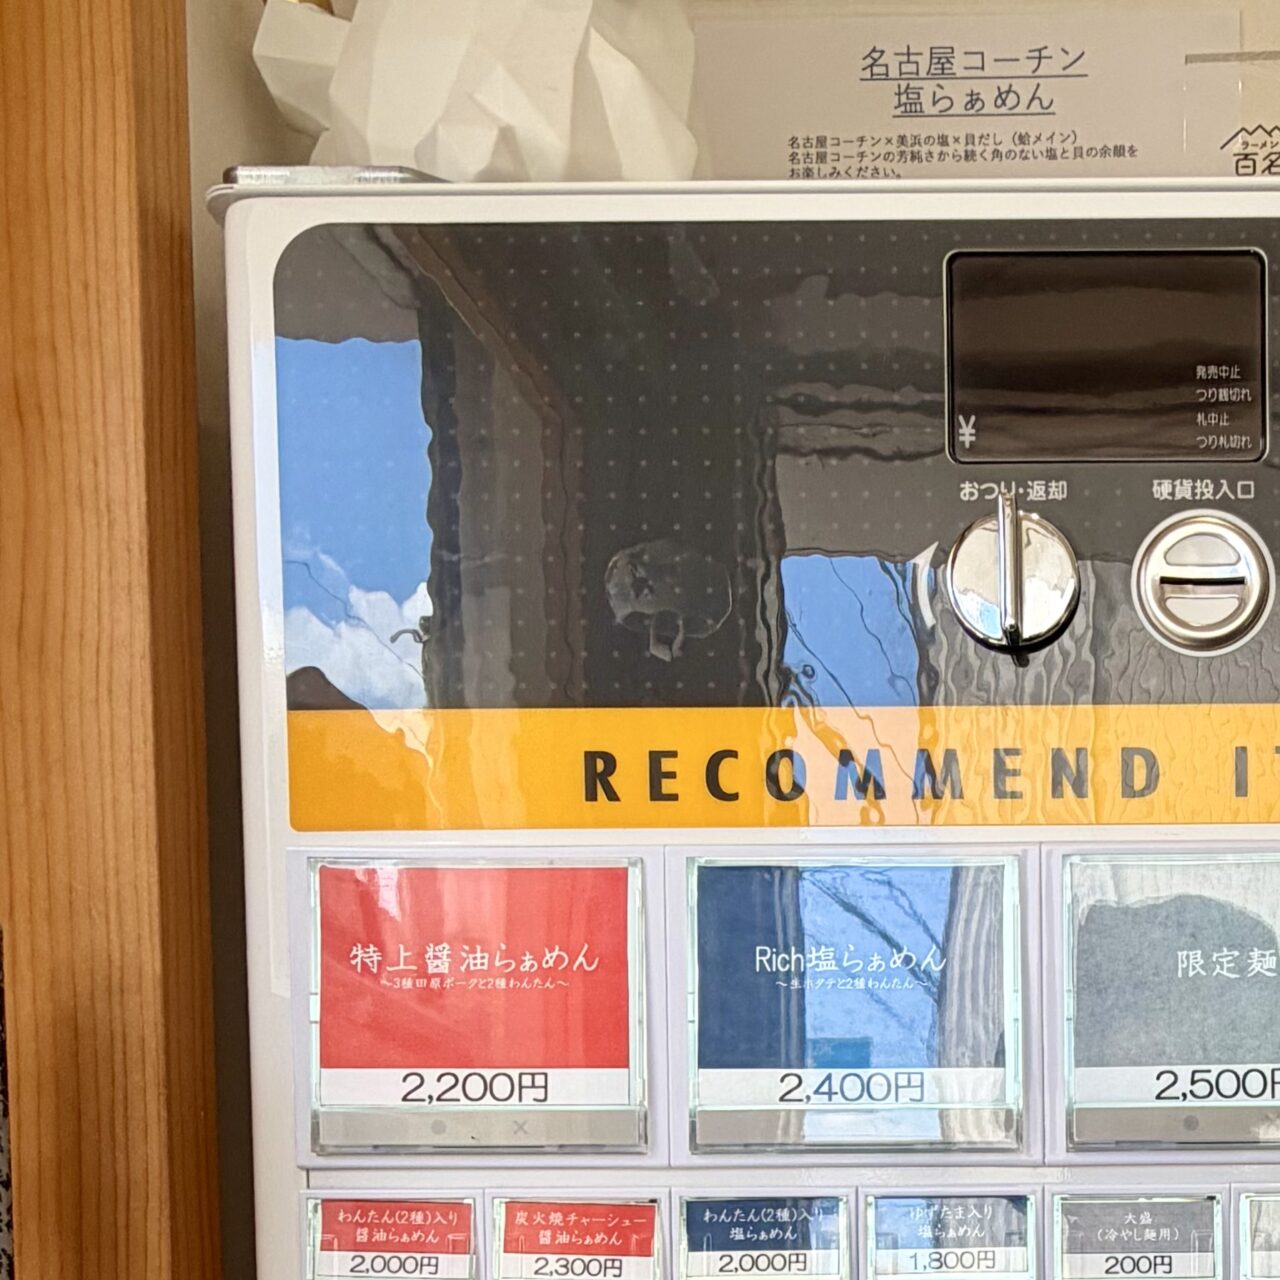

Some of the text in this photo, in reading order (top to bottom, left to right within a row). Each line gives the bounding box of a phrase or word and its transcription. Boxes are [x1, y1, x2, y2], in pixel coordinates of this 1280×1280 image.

[861, 44, 1086, 78] 名古屋コーチン
[893, 82, 1054, 114] 塩らぁめん
[1242, 140, 1279, 150] ラーメン
[1197, 411, 1230, 426] 札中止
[1197, 434, 1252, 449] つり札切れ
[1153, 479, 1255, 499] 硬貨投入口
[583, 746, 1158, 802] RECOMMEND
[350, 943, 599, 974] 特上醤油らぁめん
[756, 944, 946, 973] Rich塩らぁめん
[1177, 947, 1277, 979] 限定麺
[401, 1072, 548, 1104] 2,200円
[778, 1071, 924, 1104] 2,400円
[515, 1210, 647, 1227] 炭火焼チャーシュー
[1125, 1211, 1152, 1225] 大盛
[356, 1228, 439, 1244] 醤油らぁめん
[539, 1230, 622, 1246] 醤油らぁめん
[729, 1228, 797, 1241] 塩らぁめん
[350, 1255, 439, 1276] 2,000円
[534, 1257, 622, 1278] 2,300円
[718, 1253, 807, 1274] 2,000円
[909, 1250, 996, 1271] 1,800円
[1105, 1255, 1172, 1275] 200円
